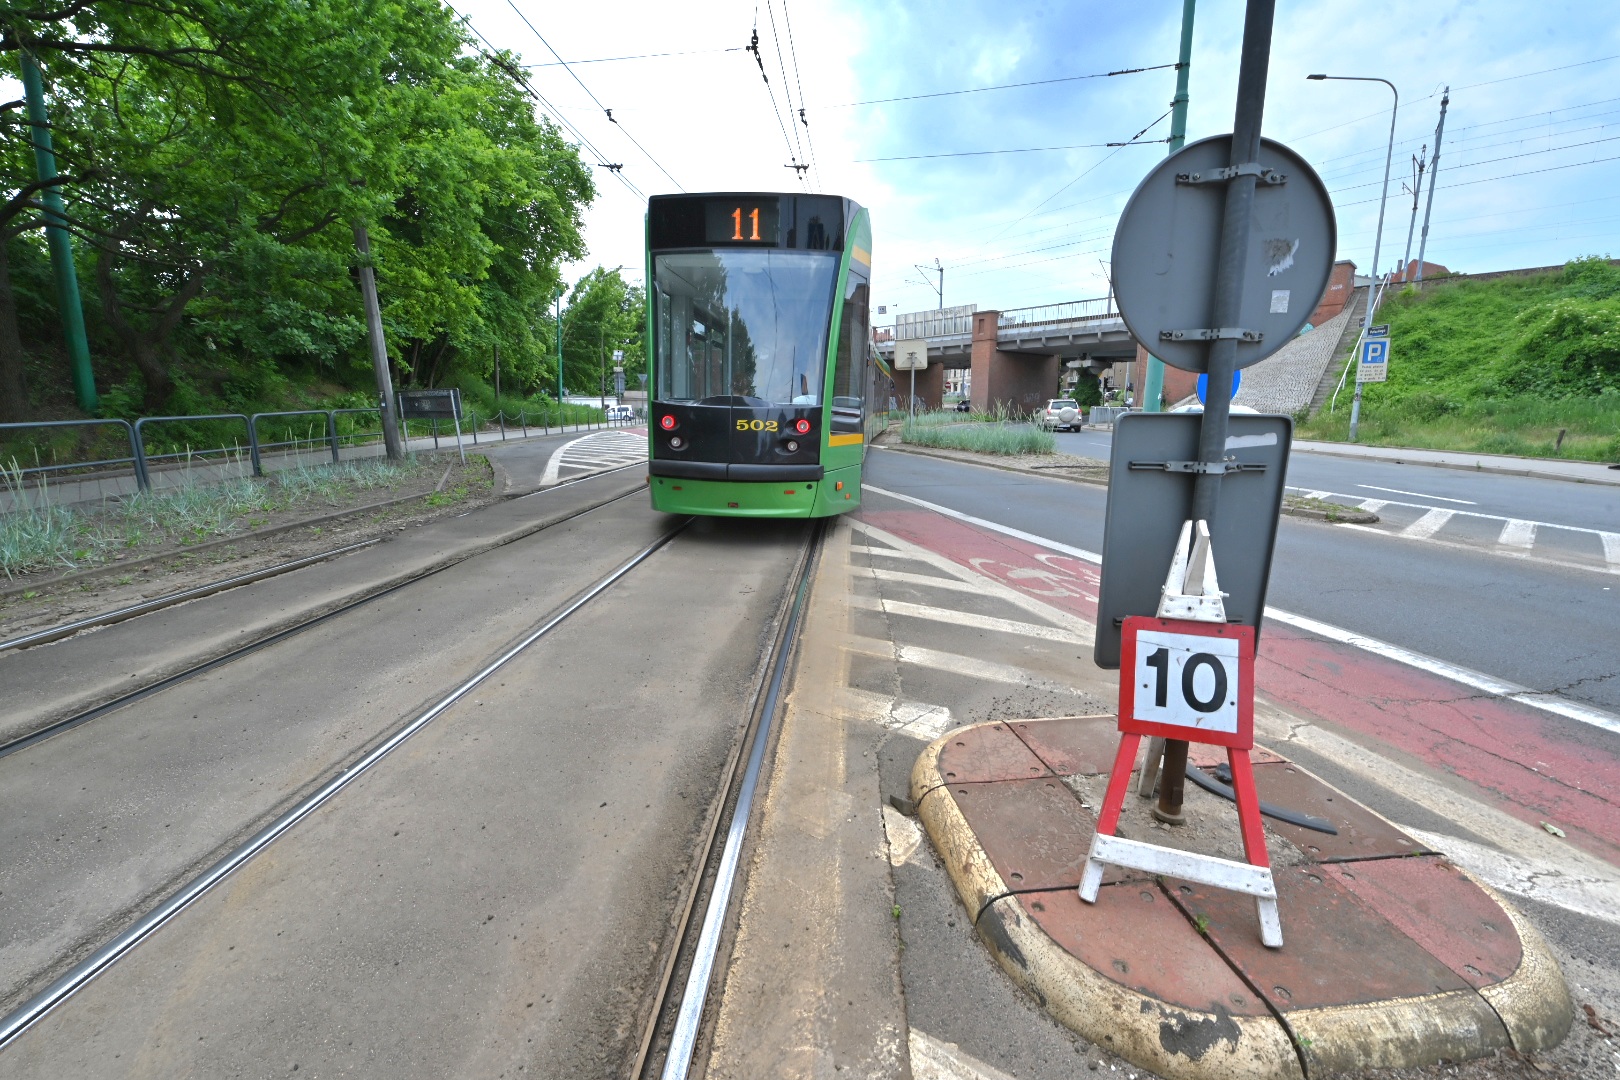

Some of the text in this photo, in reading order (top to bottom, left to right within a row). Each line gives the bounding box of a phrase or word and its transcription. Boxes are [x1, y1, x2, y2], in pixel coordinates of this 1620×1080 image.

[731, 207, 761, 240] 11
[1368, 344, 1382, 361] P
[736, 419, 778, 432] 502
[1146, 648, 1227, 712] 10
